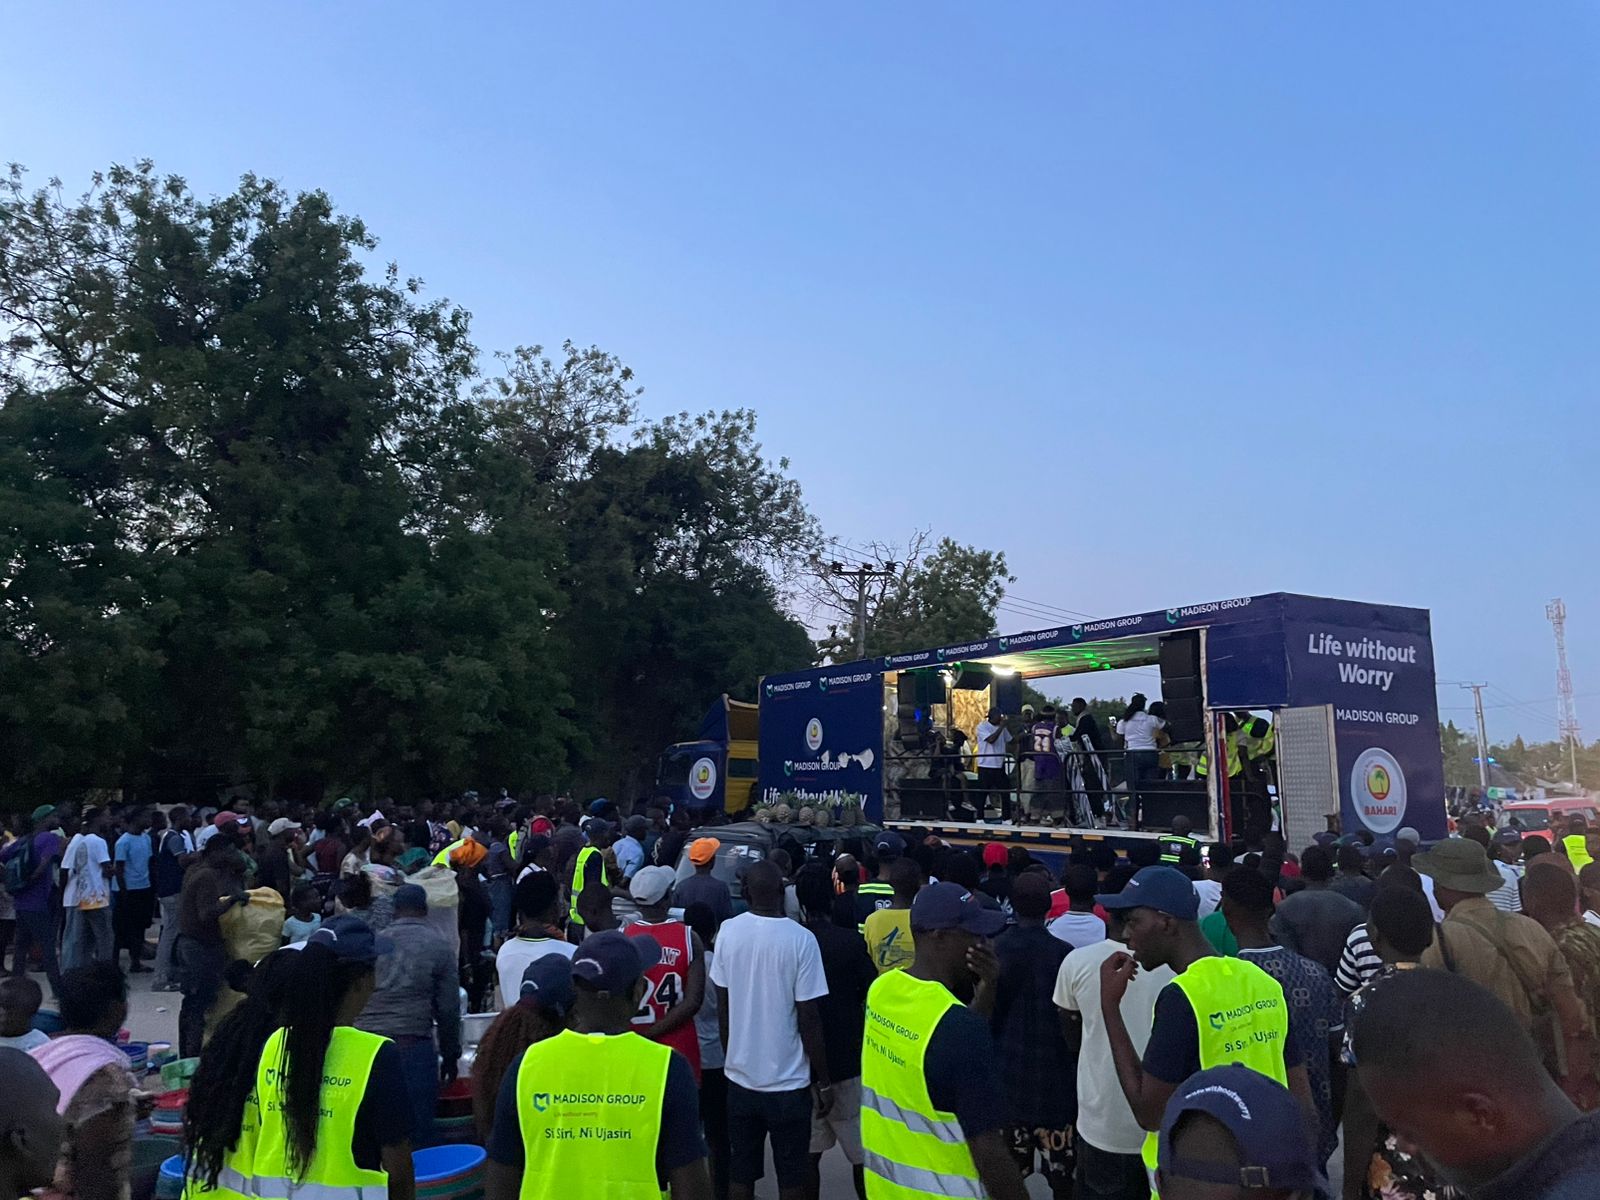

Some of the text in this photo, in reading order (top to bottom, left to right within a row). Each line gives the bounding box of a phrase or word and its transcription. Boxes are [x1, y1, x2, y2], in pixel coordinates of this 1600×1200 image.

[1180, 597, 1252, 617] MADISON GROUP
[1083, 616, 1143, 633] MADISON GROUP
[1009, 630, 1059, 645] MADISON GROUP
[944, 642, 989, 656] MADISON GROUP
[1308, 633, 1416, 664] Life without
[892, 652, 930, 664] MADISON GROUP
[828, 672, 872, 686] MADISON GROUP
[1338, 662, 1394, 692] Worry
[773, 680, 812, 693] MADISON GROUP
[1336, 708, 1419, 726] MADISON GROUP
[794, 760, 841, 771] MADISON GROUP
[763, 787, 781, 804] Lif
[630, 971, 684, 1025] 24
[1255, 998, 1278, 1010] GROUP
[895, 1025, 920, 1041] GROUP
[322, 1075, 352, 1088] ROUP
[553, 1093, 646, 1105] MADISON GROUP
[545, 1127, 632, 1141] Si Siri, Ni Ujasiri
